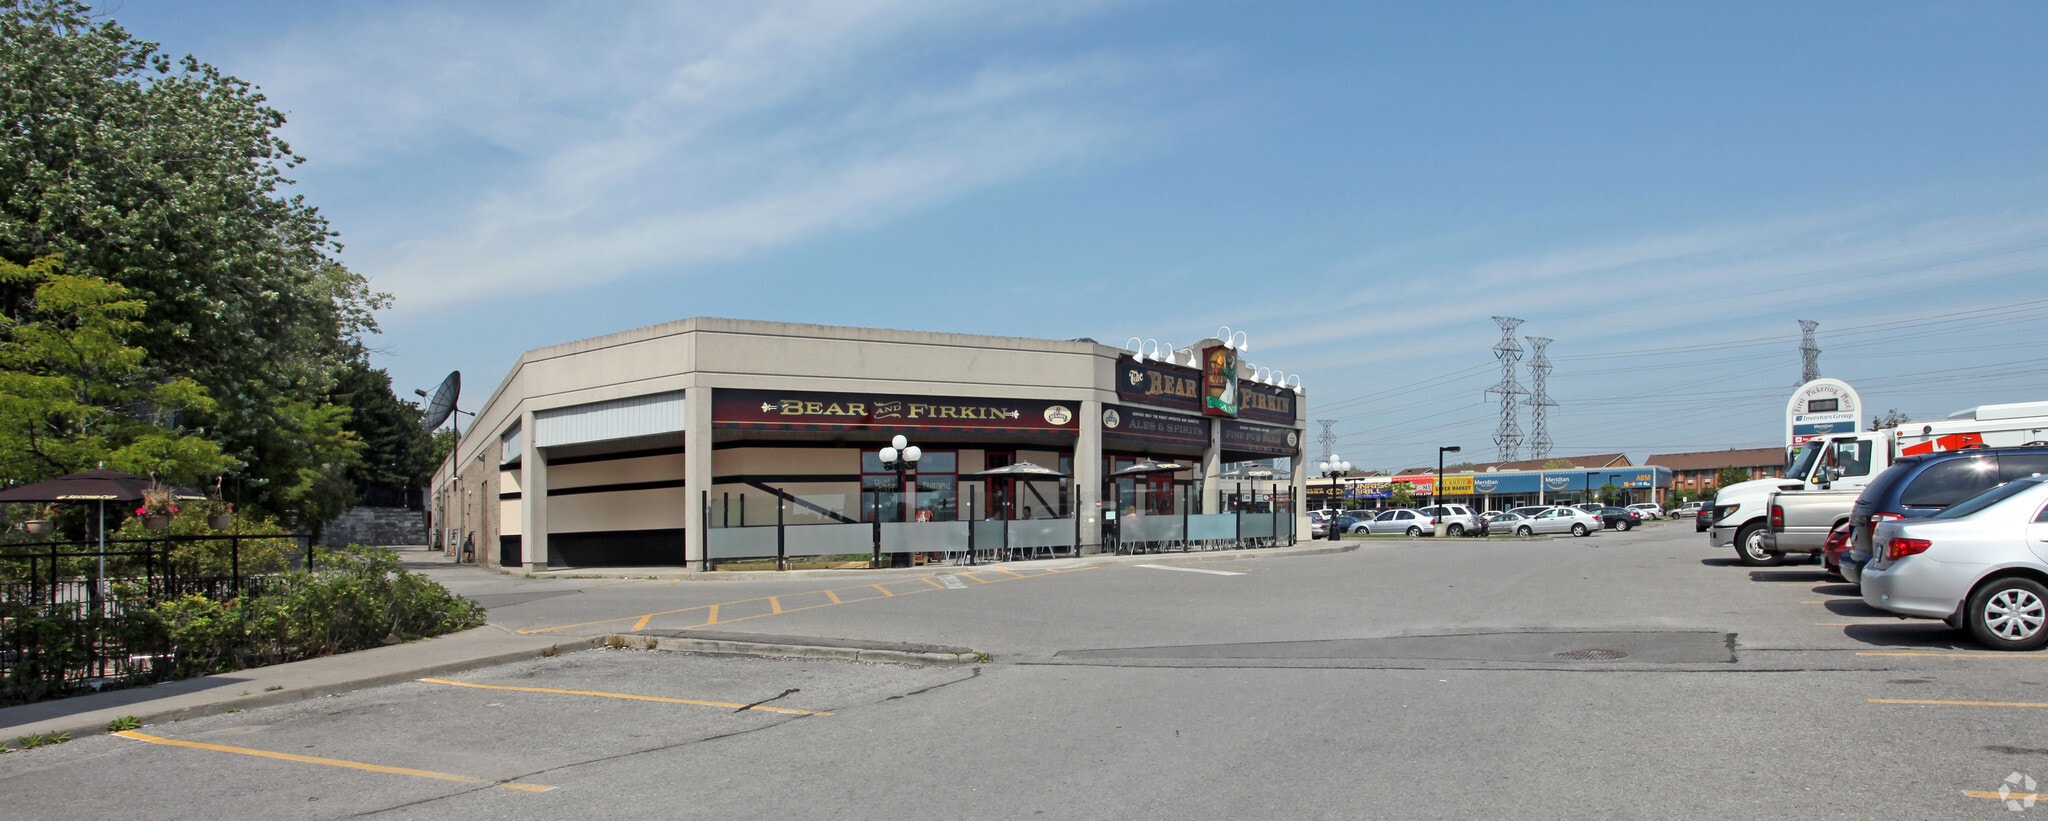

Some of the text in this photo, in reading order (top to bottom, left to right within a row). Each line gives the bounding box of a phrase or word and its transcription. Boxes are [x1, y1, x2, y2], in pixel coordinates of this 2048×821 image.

[1145, 370, 1197, 398] BEAR
[780, 400, 1007, 420] BEAR AND FIRKIN
[1239, 387, 1290, 413] FIRKIN
[1794, 386, 1851, 412] First Pickering Place
[1129, 420, 1156, 430] ALES
[1167, 423, 1203, 436] SPIRITS
